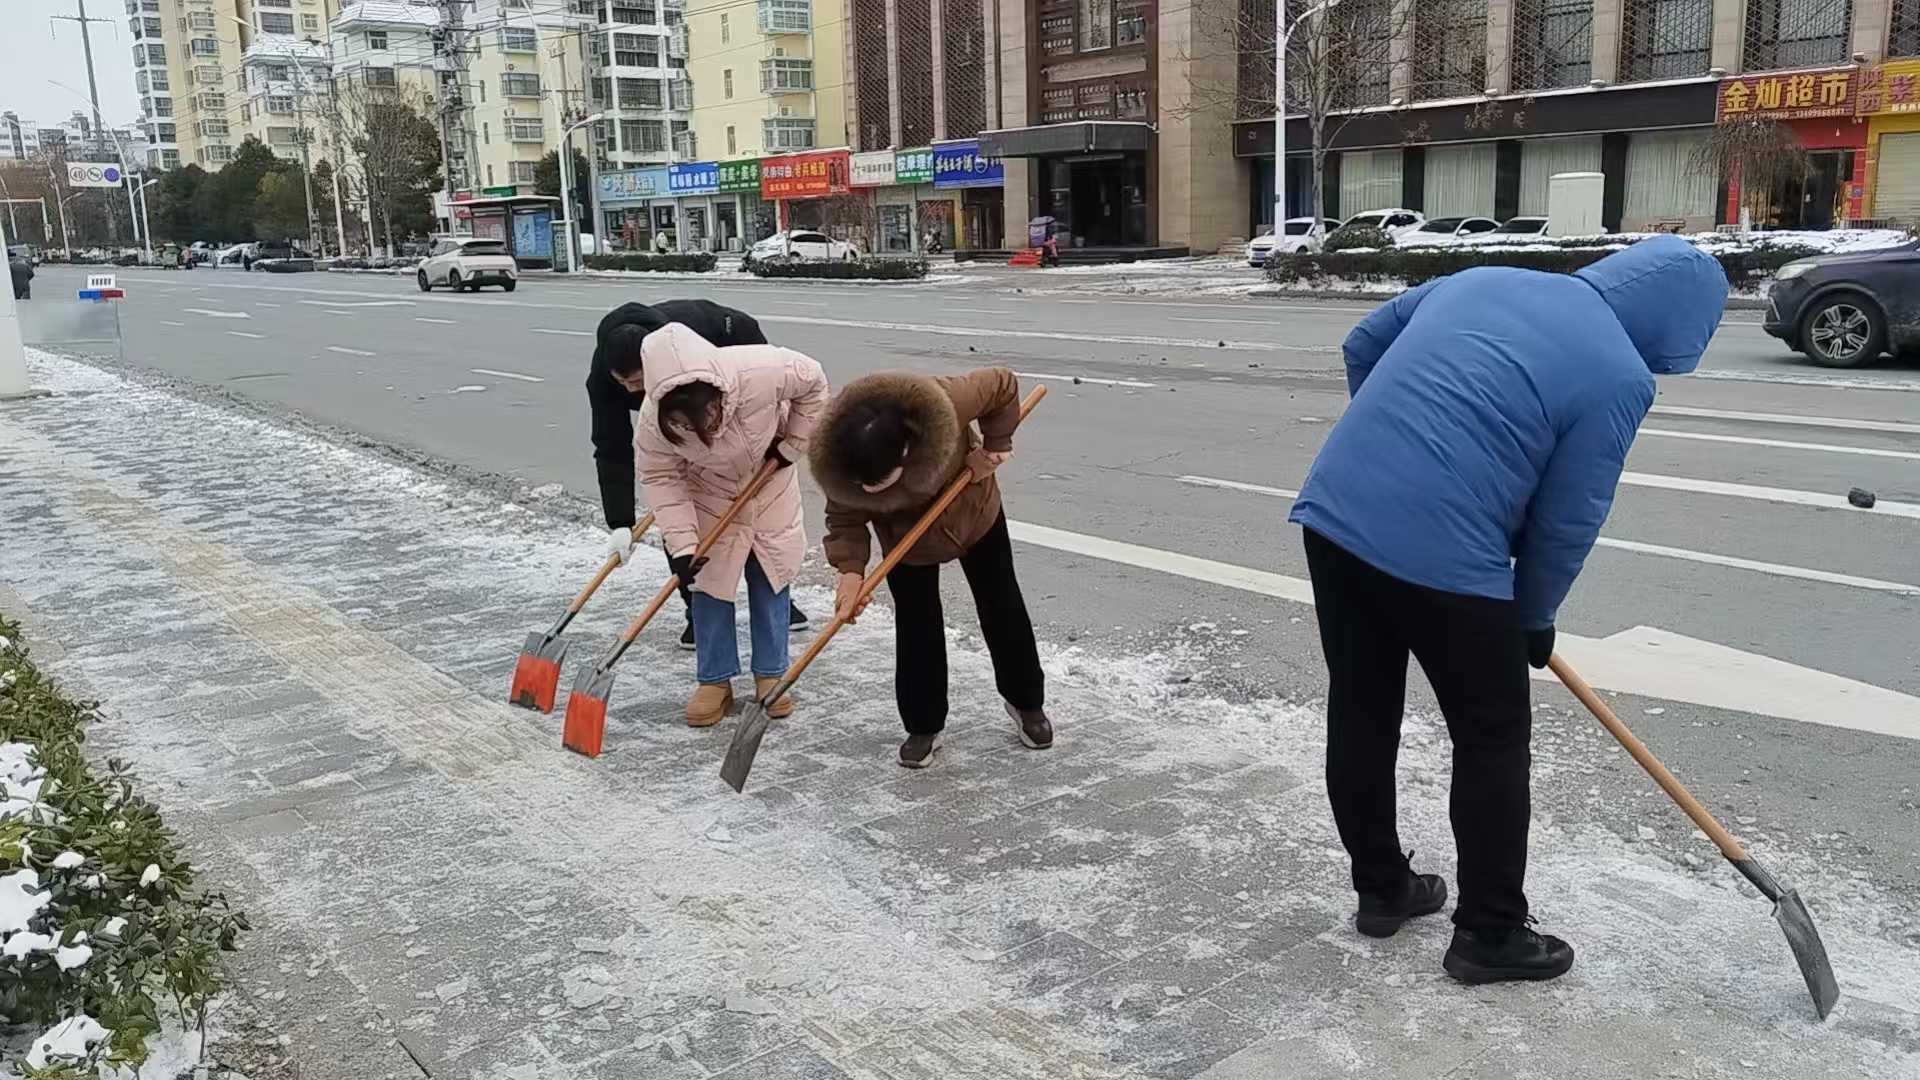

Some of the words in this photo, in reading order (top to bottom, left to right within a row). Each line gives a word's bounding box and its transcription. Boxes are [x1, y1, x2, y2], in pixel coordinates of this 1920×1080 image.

[1723, 73, 1850, 113] 金灿超市
[73, 170, 82, 179] 40
